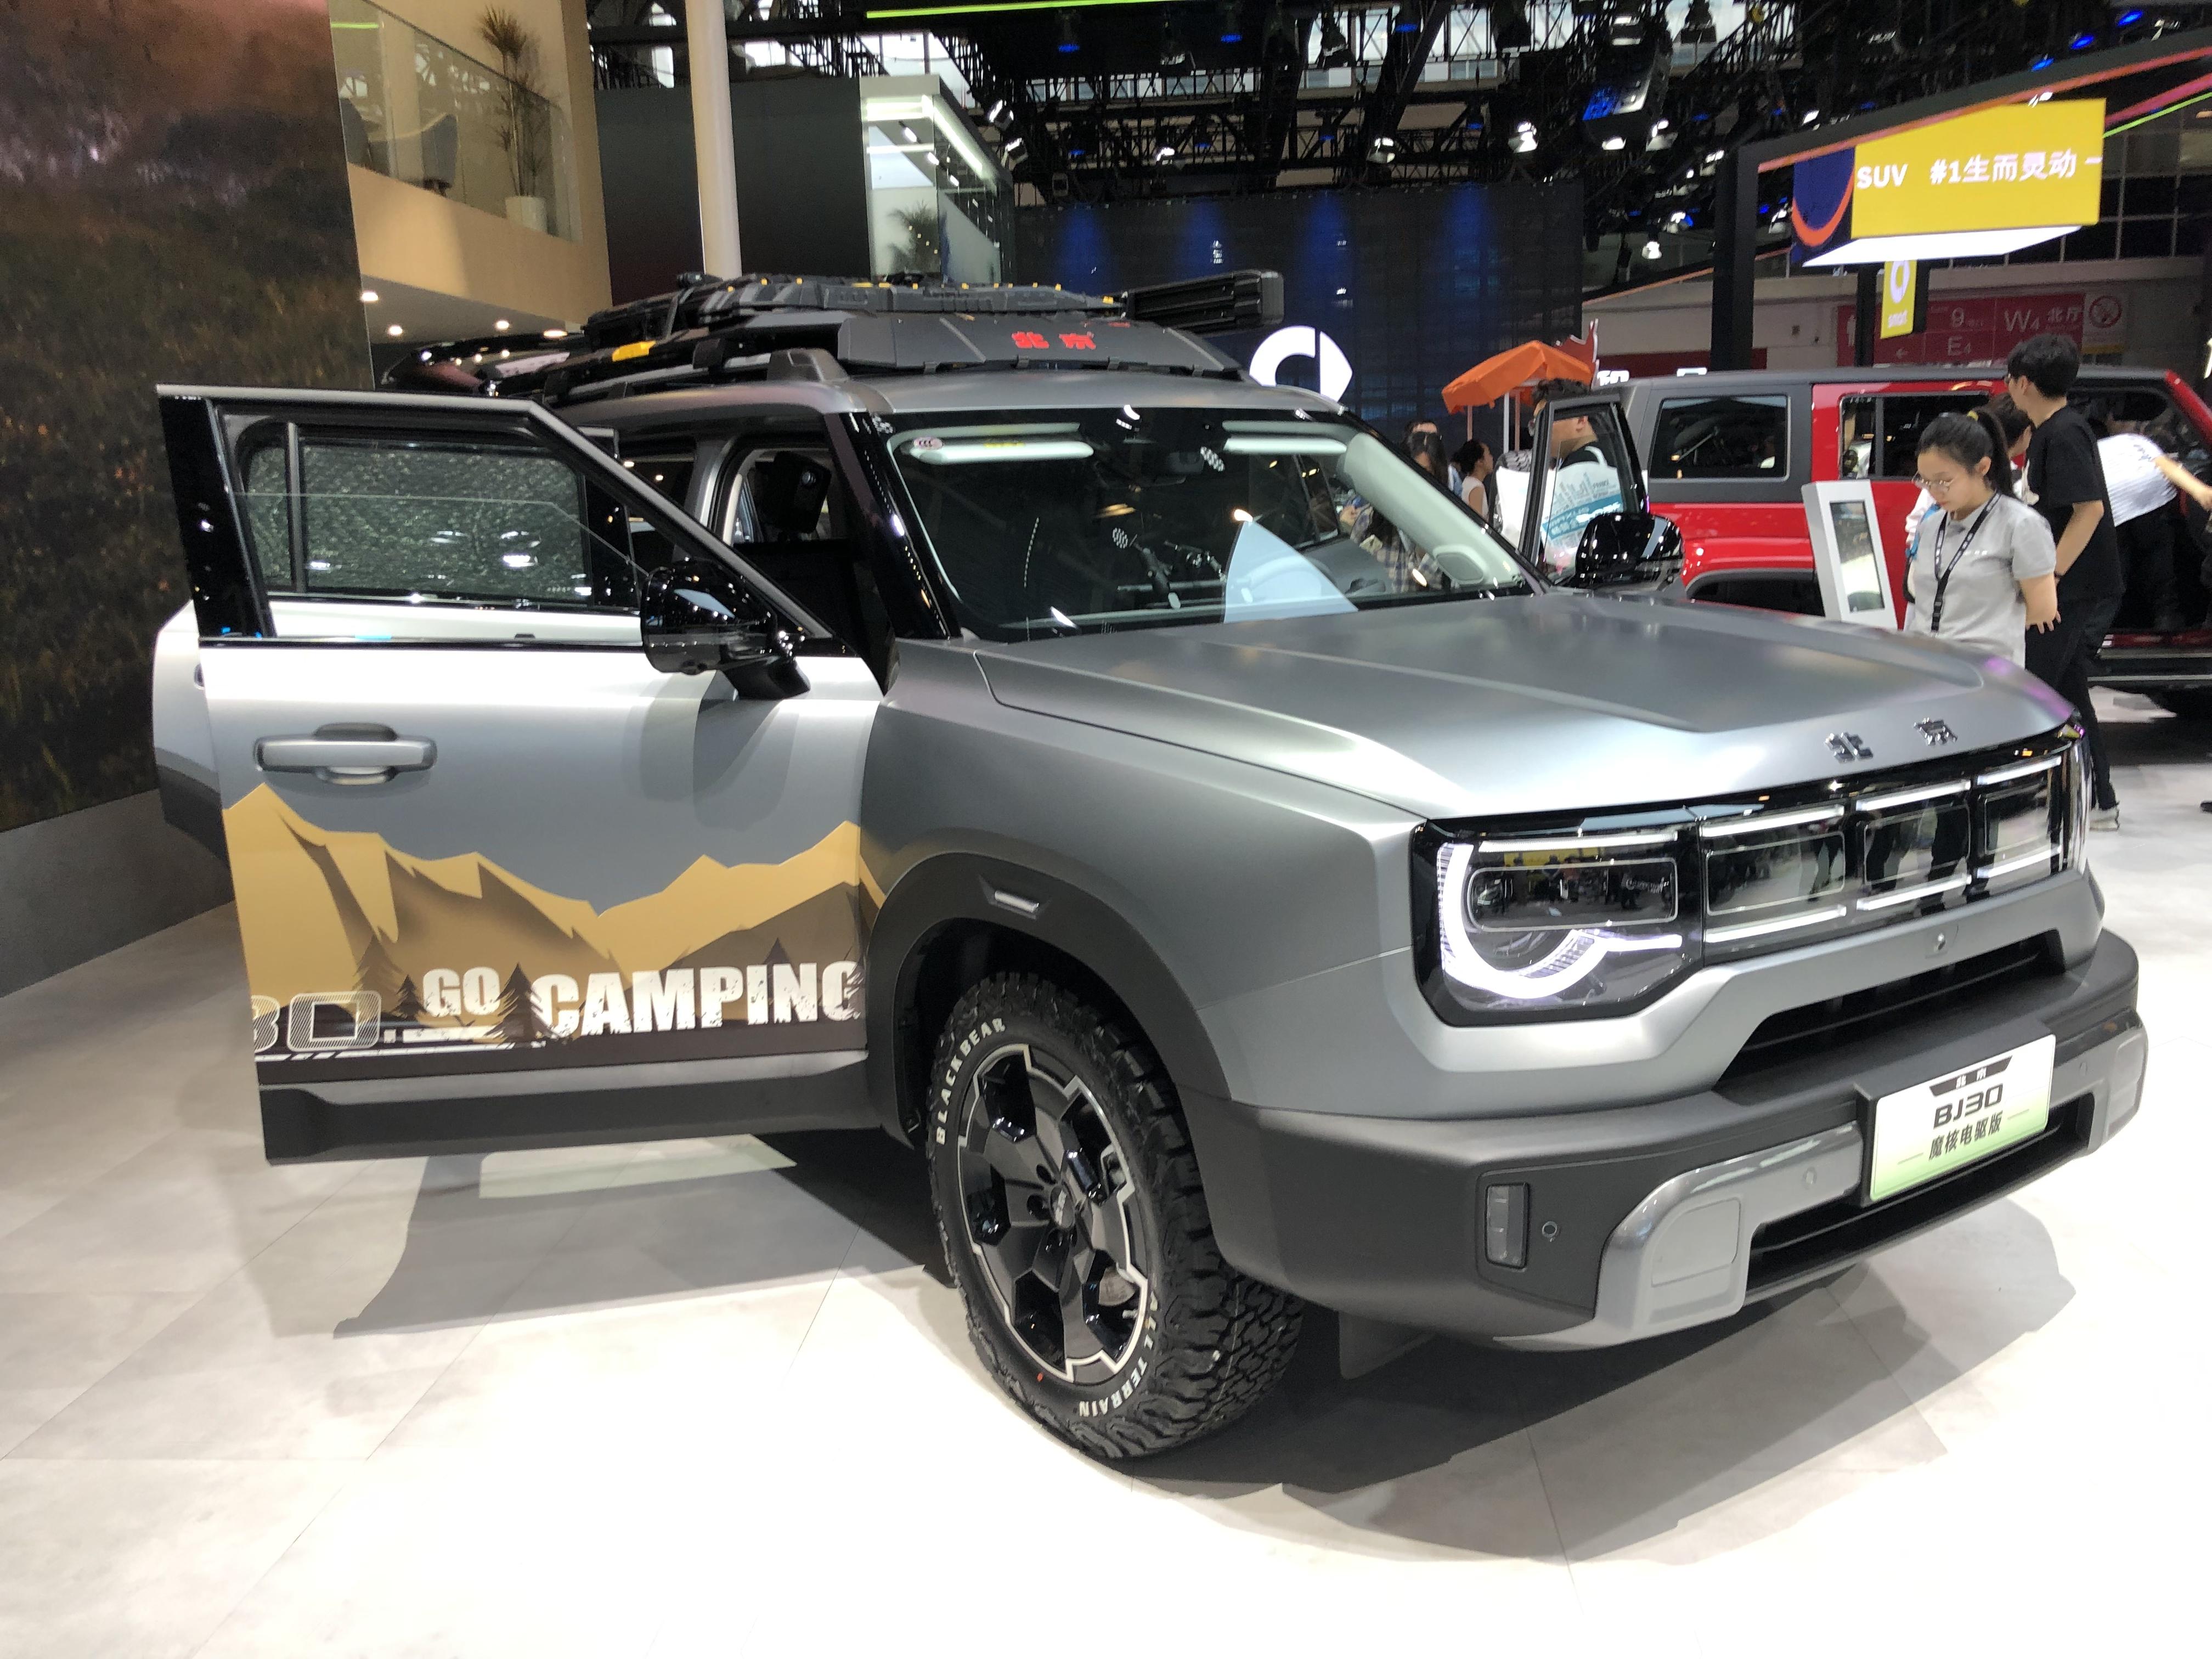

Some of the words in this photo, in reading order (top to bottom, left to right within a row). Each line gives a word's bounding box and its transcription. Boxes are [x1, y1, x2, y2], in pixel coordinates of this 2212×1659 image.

[1857, 164, 1908, 189] SUV
[423, 966, 500, 1017] GO
[530, 960, 866, 1039] CAMPING
[1933, 1082, 2004, 1130] BJ30
[1928, 1110, 2004, 1161] 魔核电驱版
[1079, 1356, 1148, 1418] TERRAIN
